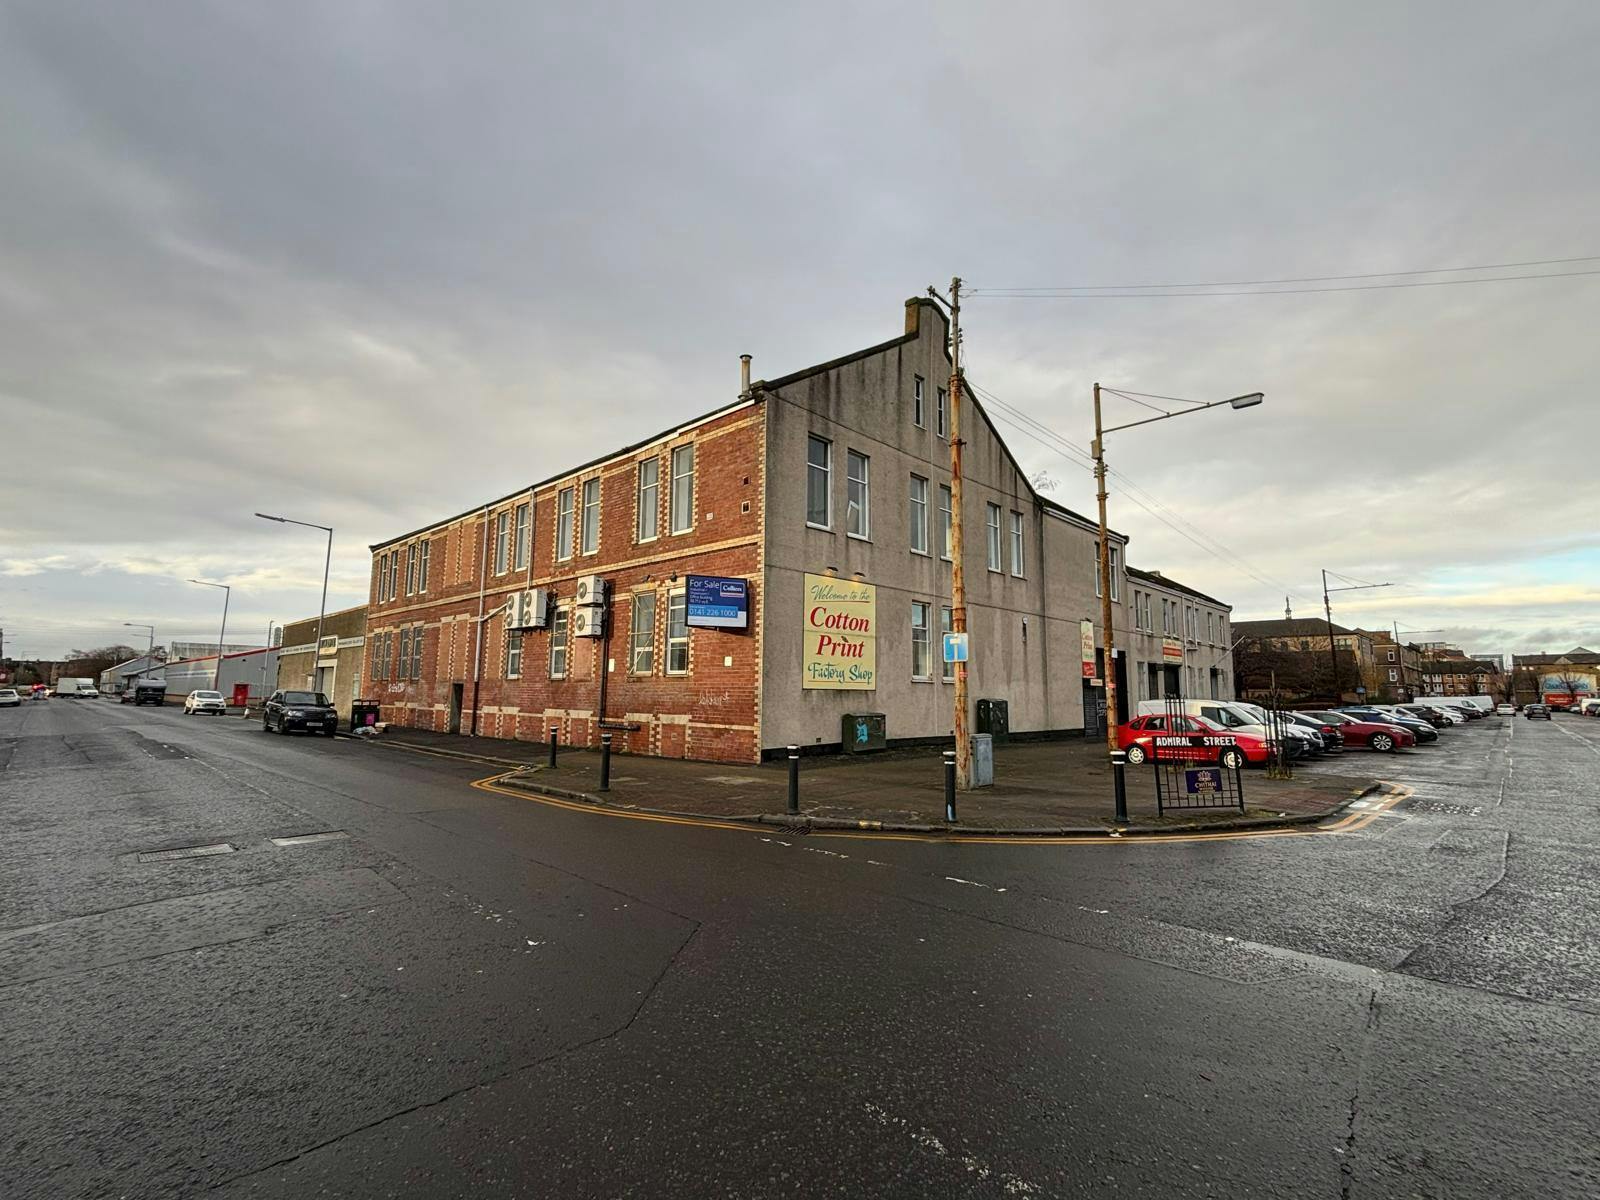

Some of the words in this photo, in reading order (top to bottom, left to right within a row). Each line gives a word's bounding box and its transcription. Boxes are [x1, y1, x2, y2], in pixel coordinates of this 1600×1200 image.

[690, 579, 702, 587] For
[704, 580, 719, 589] Sale
[811, 585, 847, 600] Welcome
[849, 591, 857, 600] to
[859, 587, 870, 600] the
[720, 609, 736, 617] 1000
[810, 606, 869, 632] Cotton
[816, 634, 865, 658] Print
[808, 662, 845, 684] Factory
[849, 664, 873, 685] Shop
[1156, 736, 1192, 746] ADMIRAL
[1203, 736, 1236, 746] STREET
